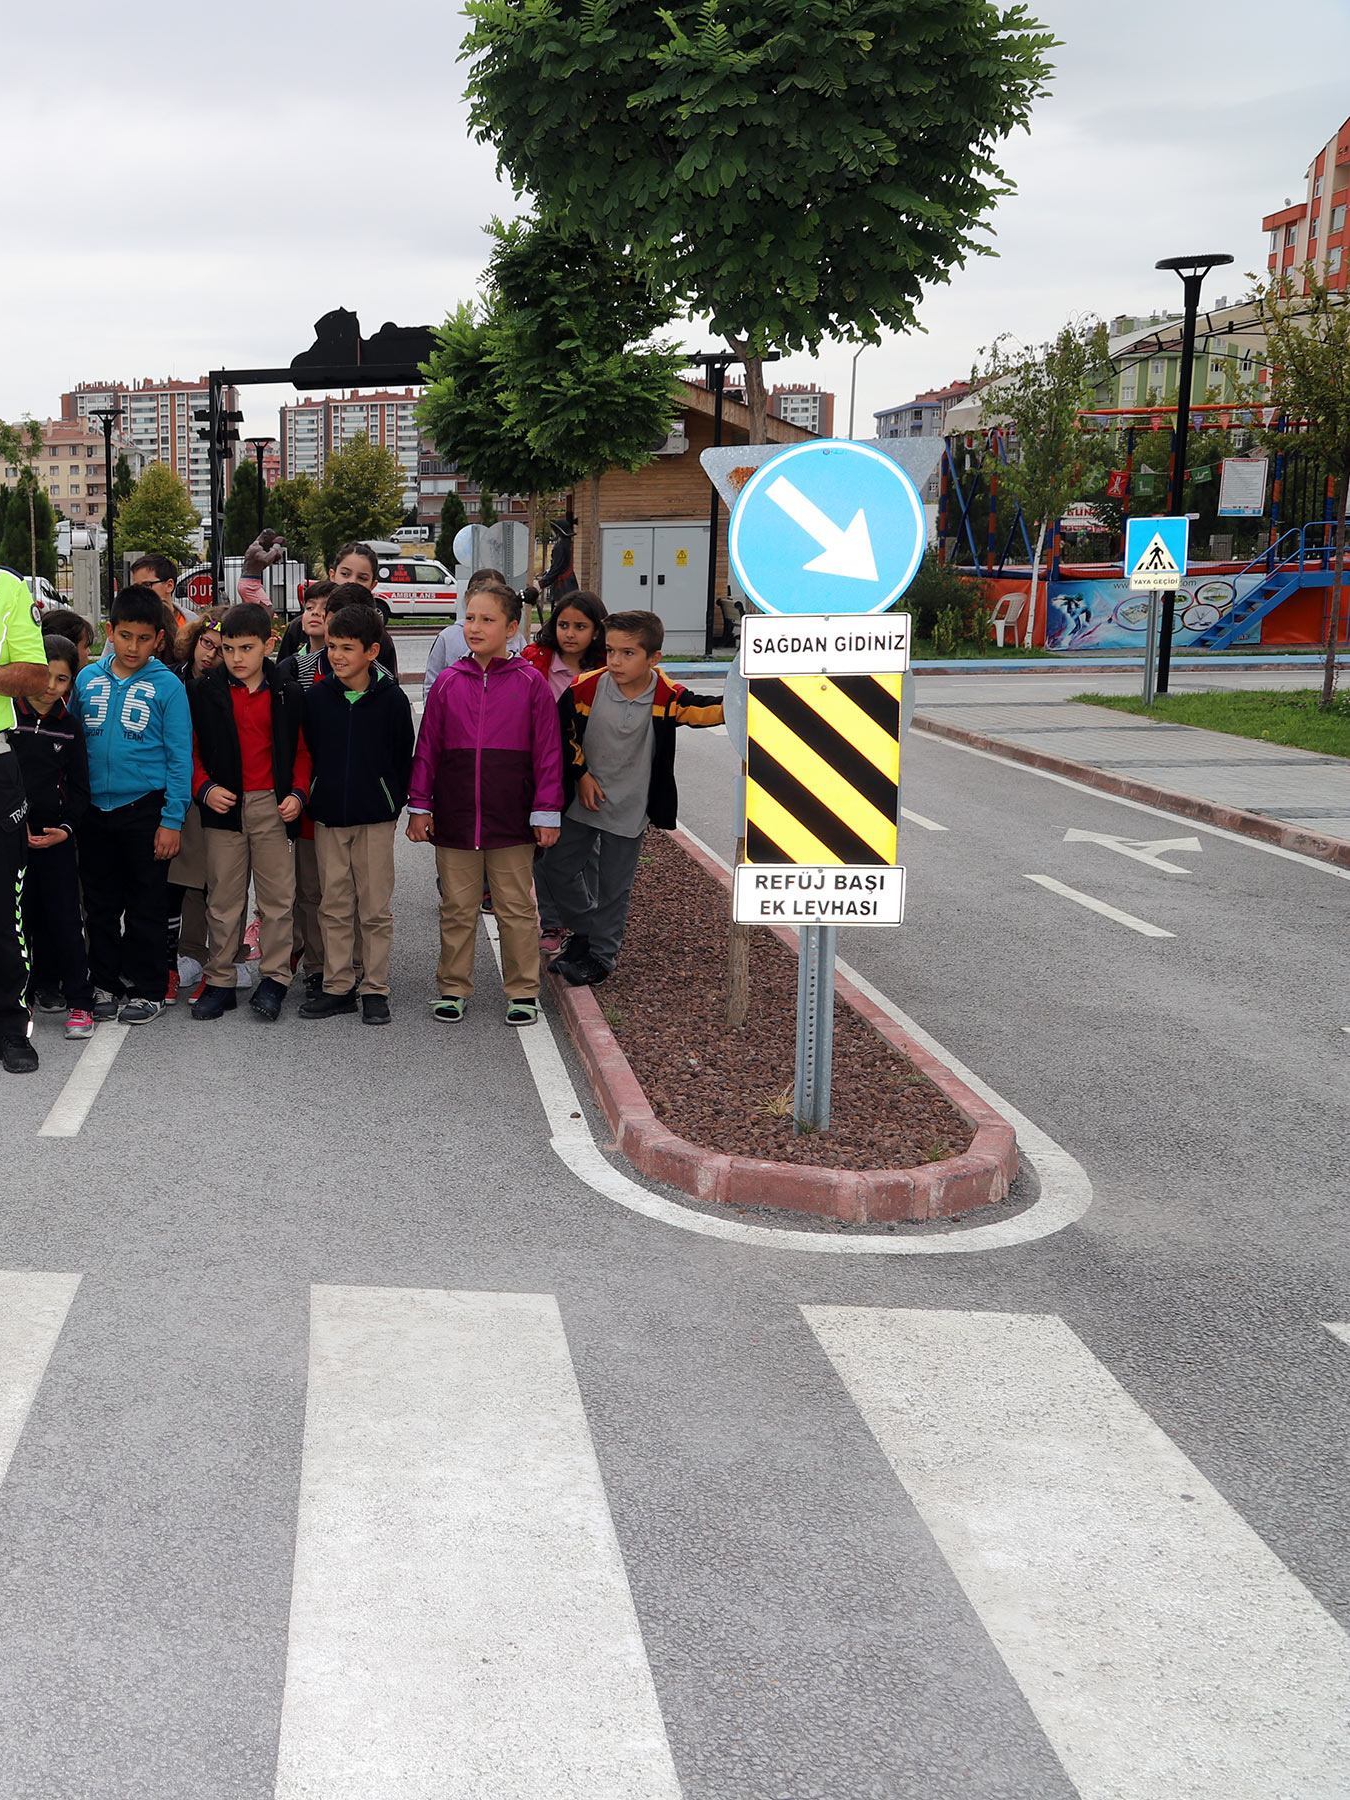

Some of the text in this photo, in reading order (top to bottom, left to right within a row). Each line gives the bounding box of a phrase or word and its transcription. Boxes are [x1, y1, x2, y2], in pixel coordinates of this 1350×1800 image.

[1153, 578, 1178, 586] GEÇİDİ
[752, 631, 906, 654] SAĞDAN GİDİNİZ
[123, 730, 144, 742] TEAM
[755, 871, 886, 894] REFÜJ BAŞI
[760, 900, 878, 917] EK LEVHASI
